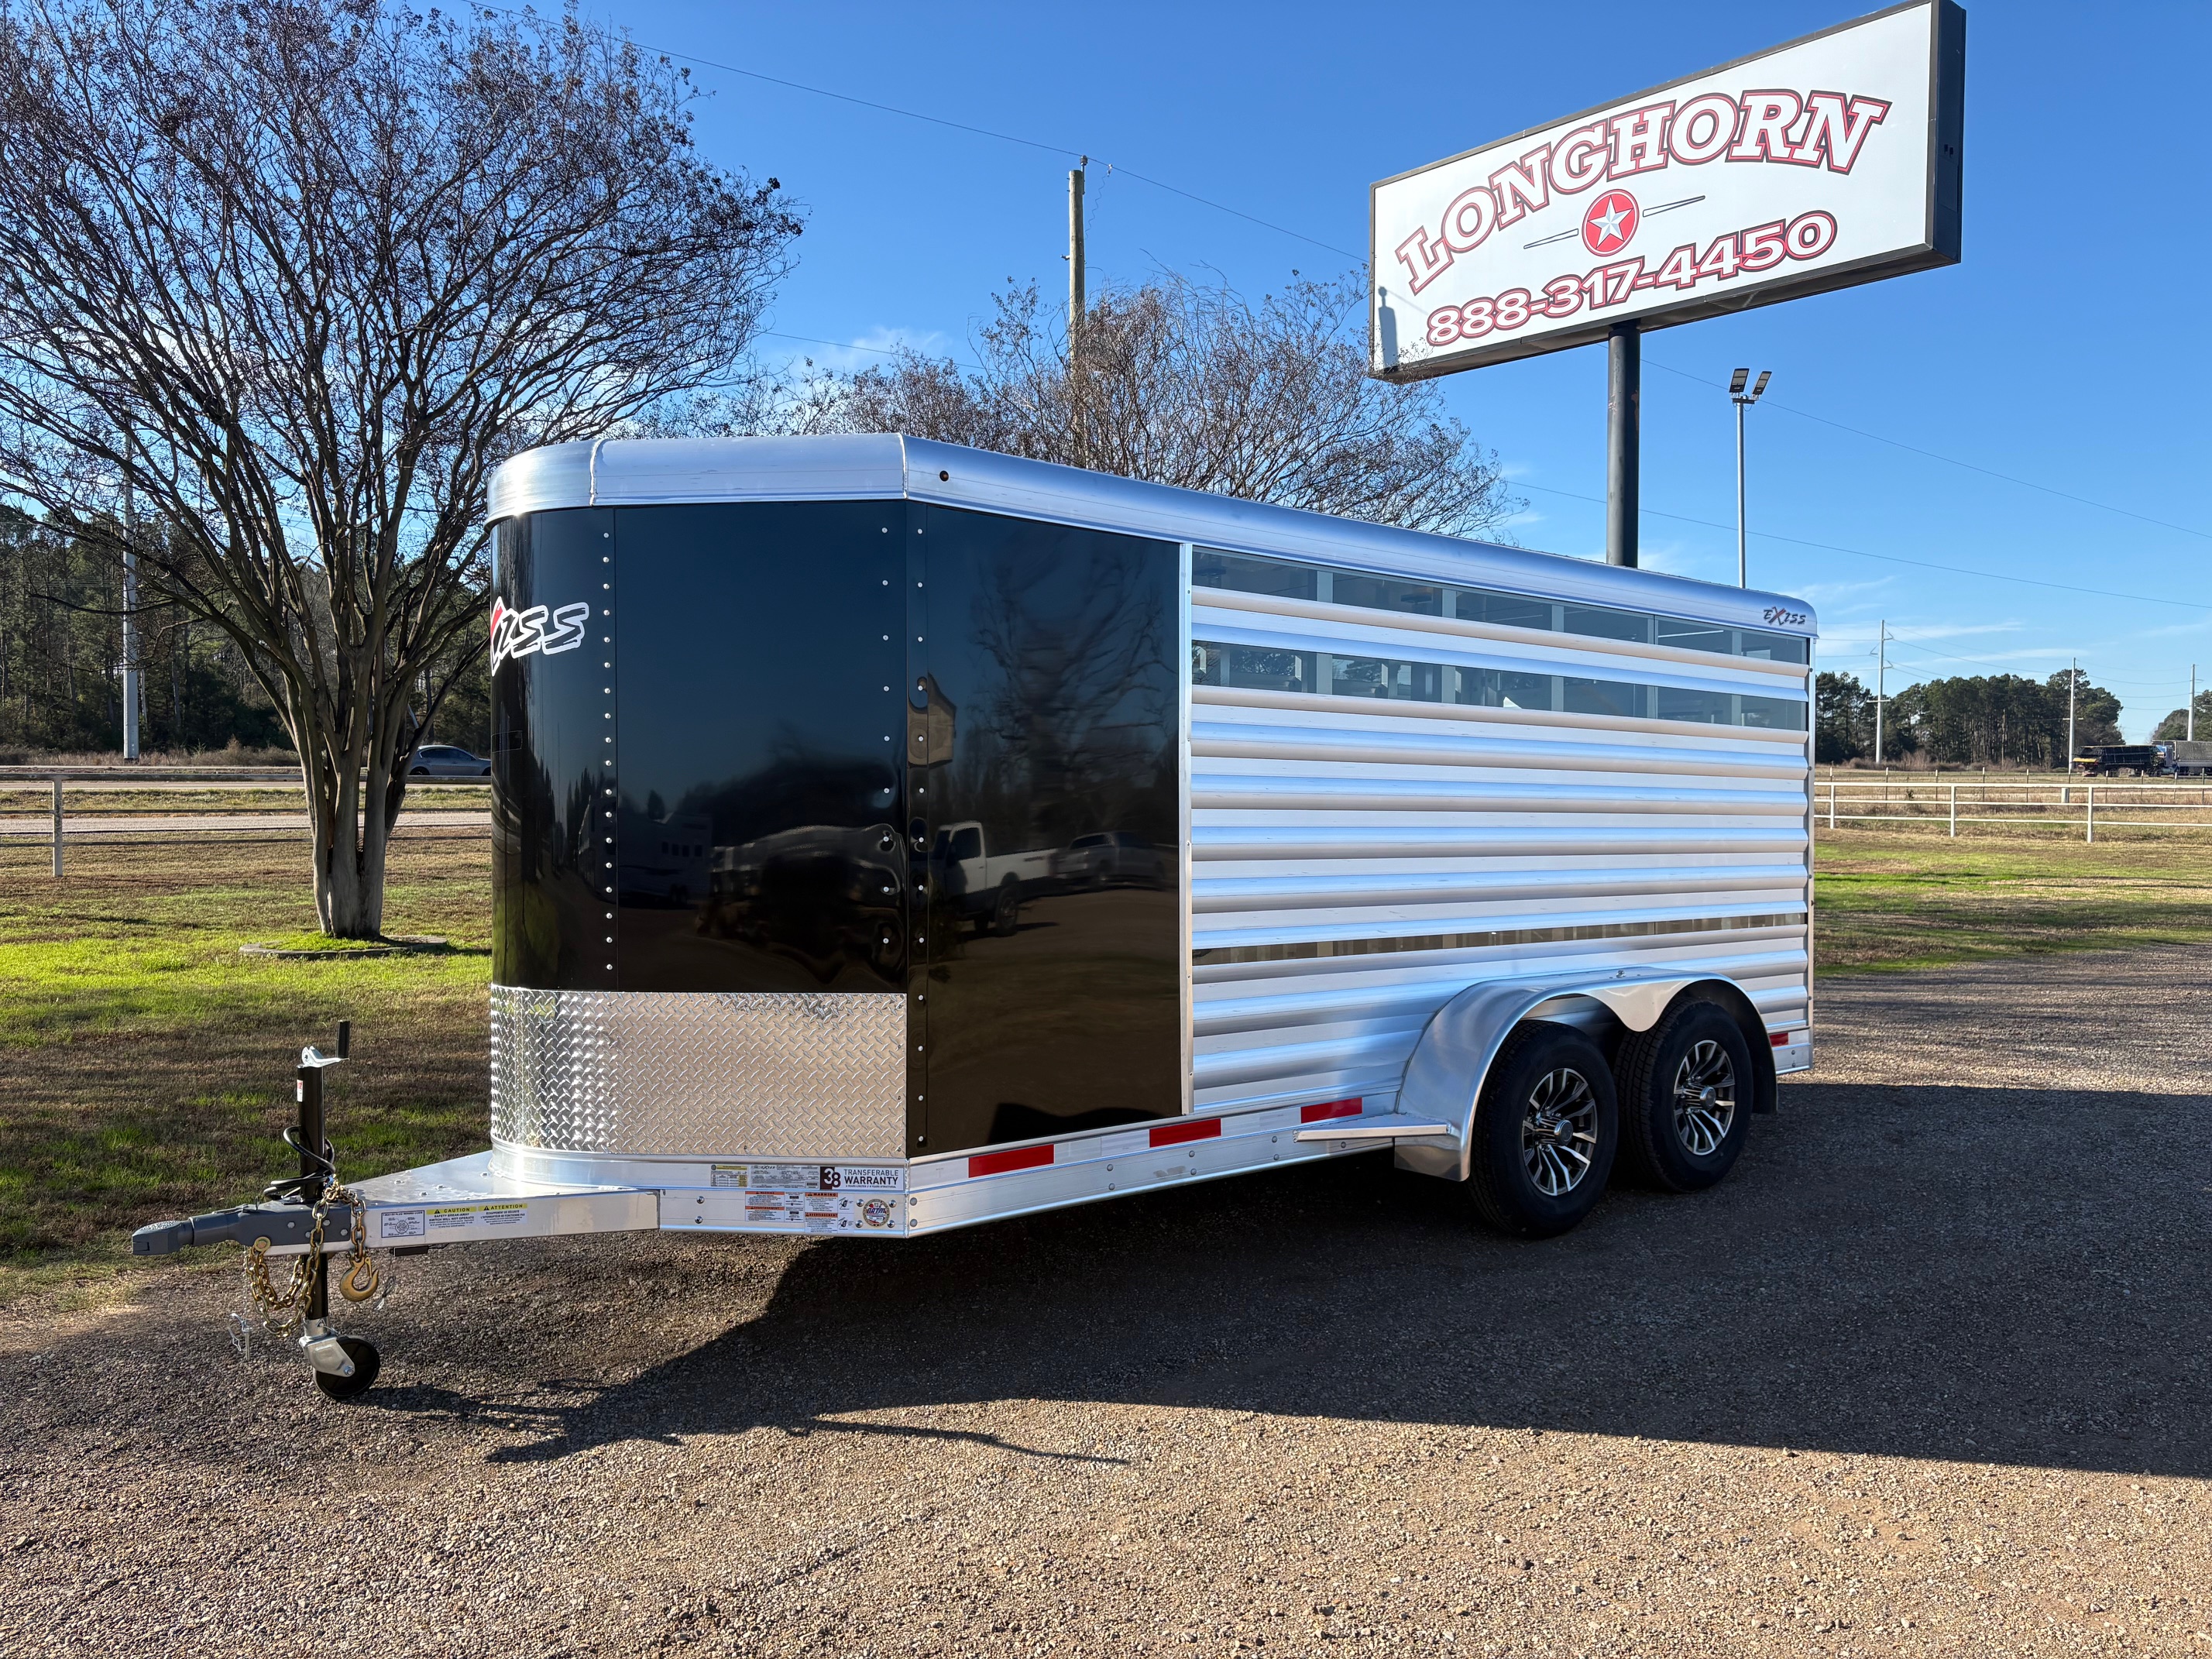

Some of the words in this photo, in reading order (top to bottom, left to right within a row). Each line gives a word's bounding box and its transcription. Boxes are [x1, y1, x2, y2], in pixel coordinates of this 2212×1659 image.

[1395, 88, 1891, 295] LONGHORN
[1427, 210, 1838, 346] 888-317-4450
[844, 1176, 898, 1185] WARRANTY
